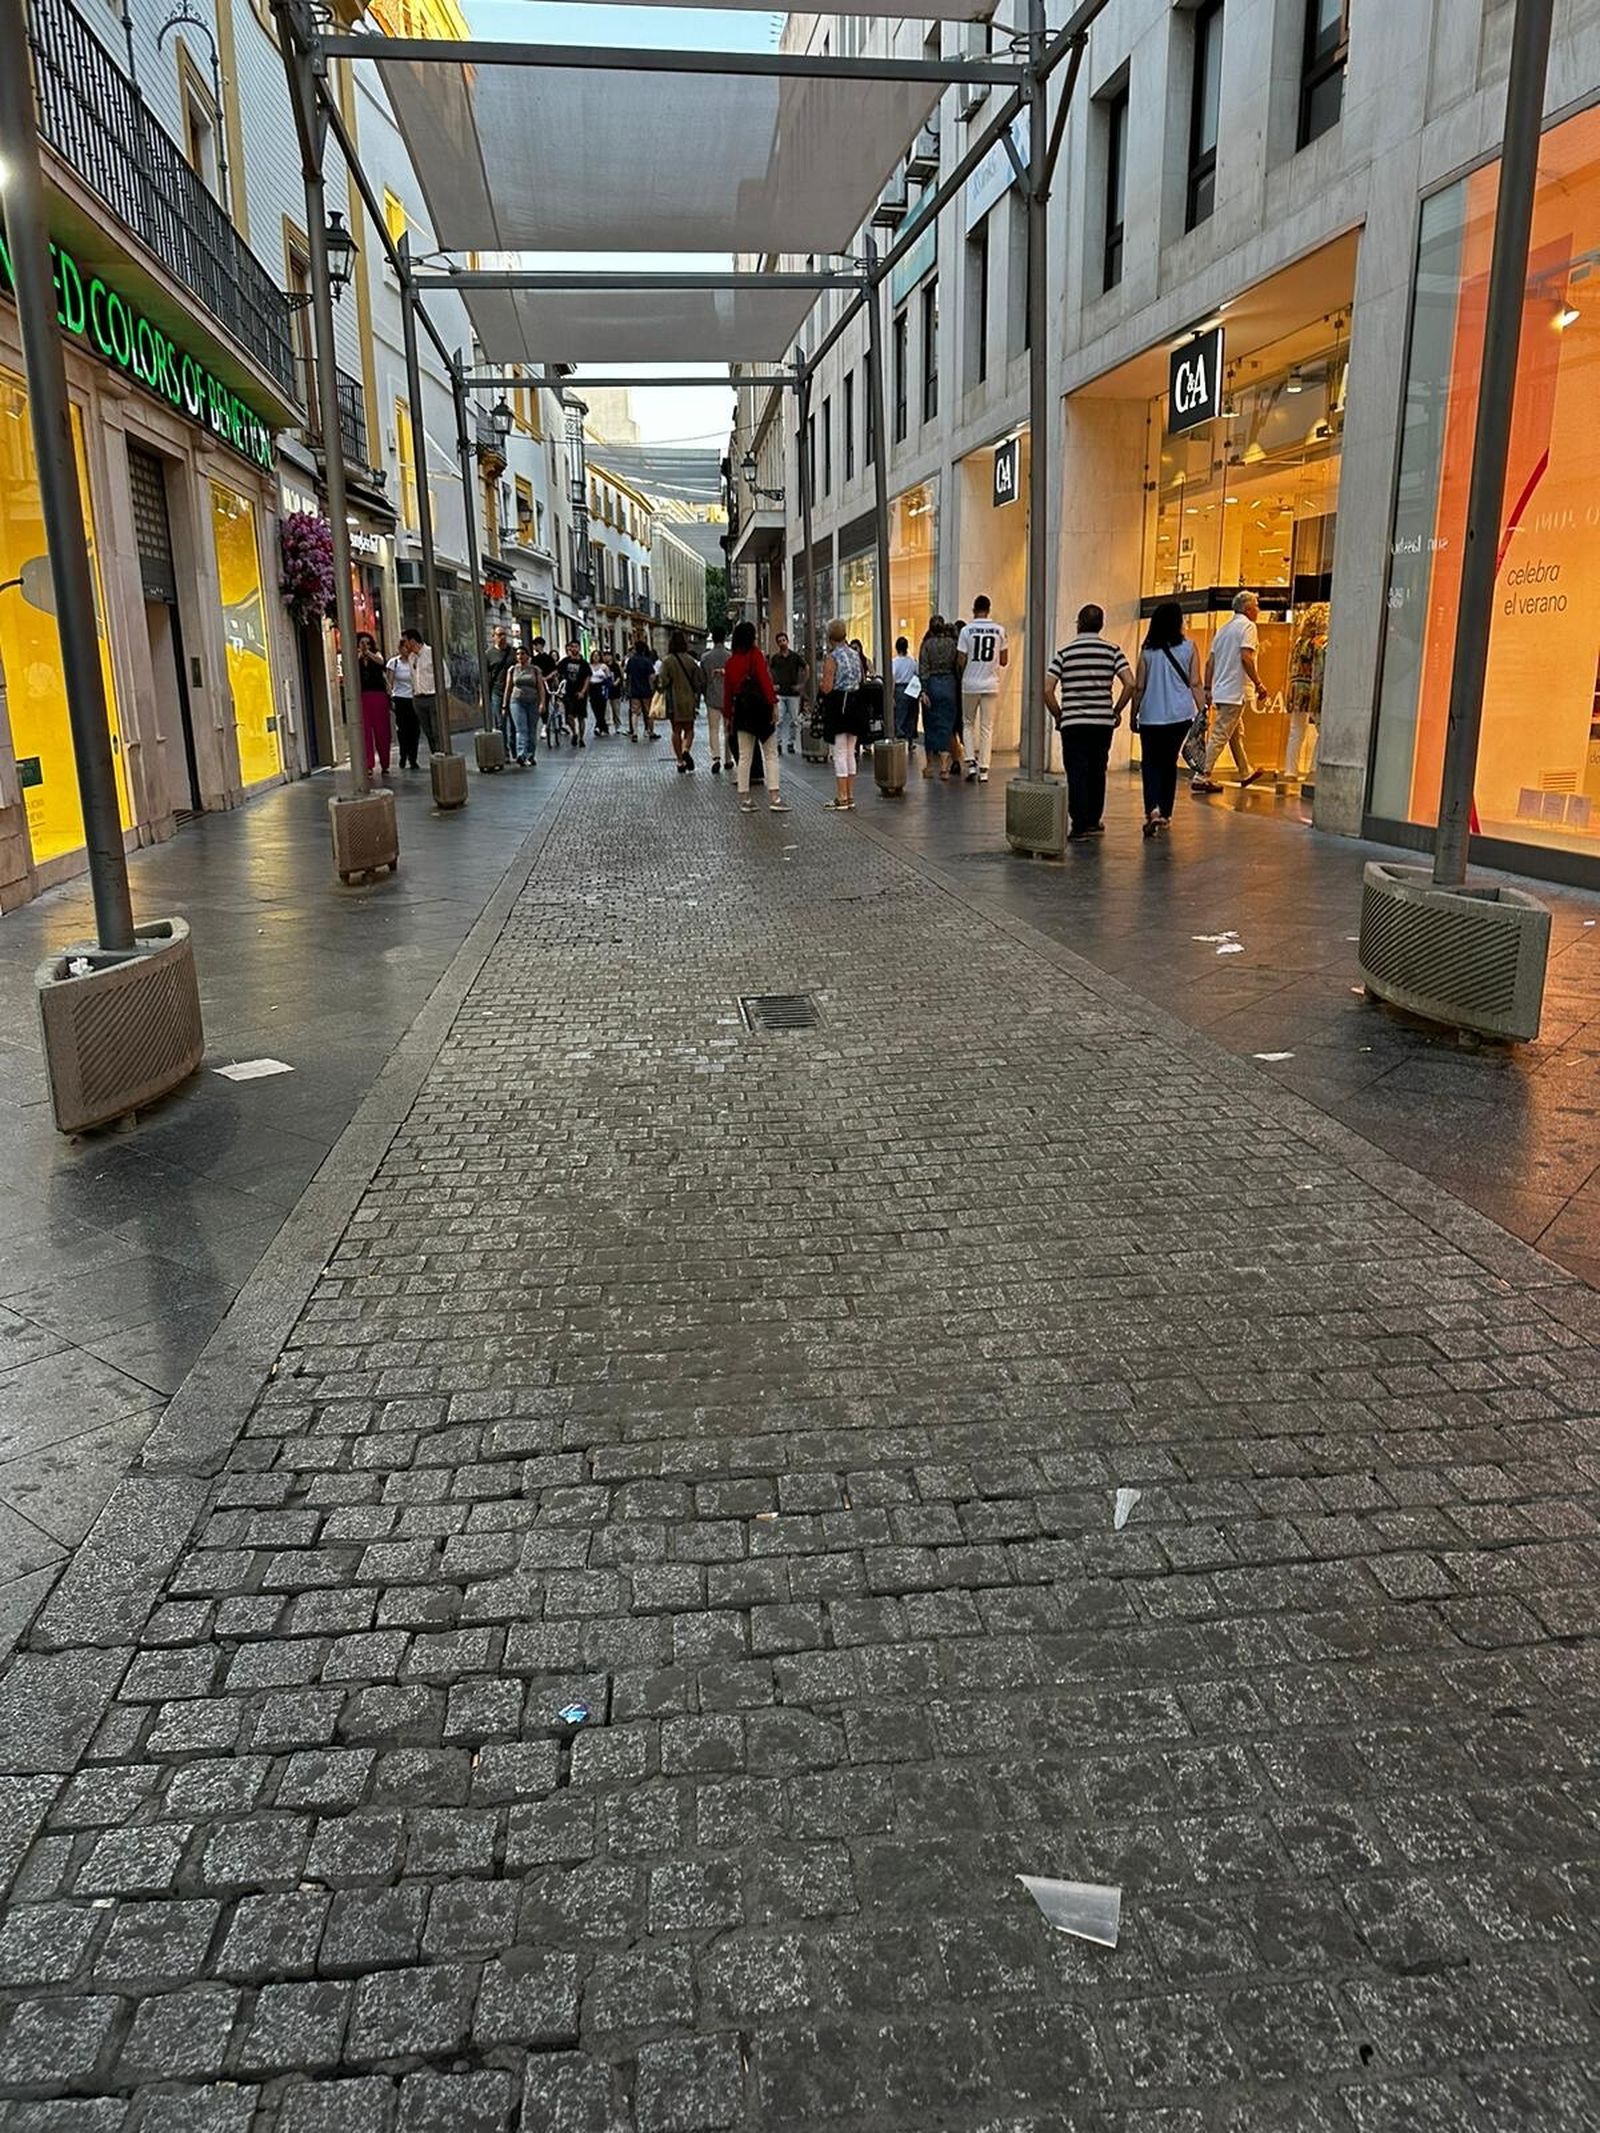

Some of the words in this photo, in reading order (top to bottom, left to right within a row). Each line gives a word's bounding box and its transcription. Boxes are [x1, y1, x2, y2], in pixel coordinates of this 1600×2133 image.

[90, 278, 180, 405] COLORS
[182, 354, 206, 421] OF
[207, 373, 274, 472] BENETTON
[1175, 353, 1209, 414] C&A
[1507, 559, 1561, 587] celebra
[1504, 591, 1517, 616] el
[1519, 594, 1568, 615] verano
[972, 635, 996, 662] 18
